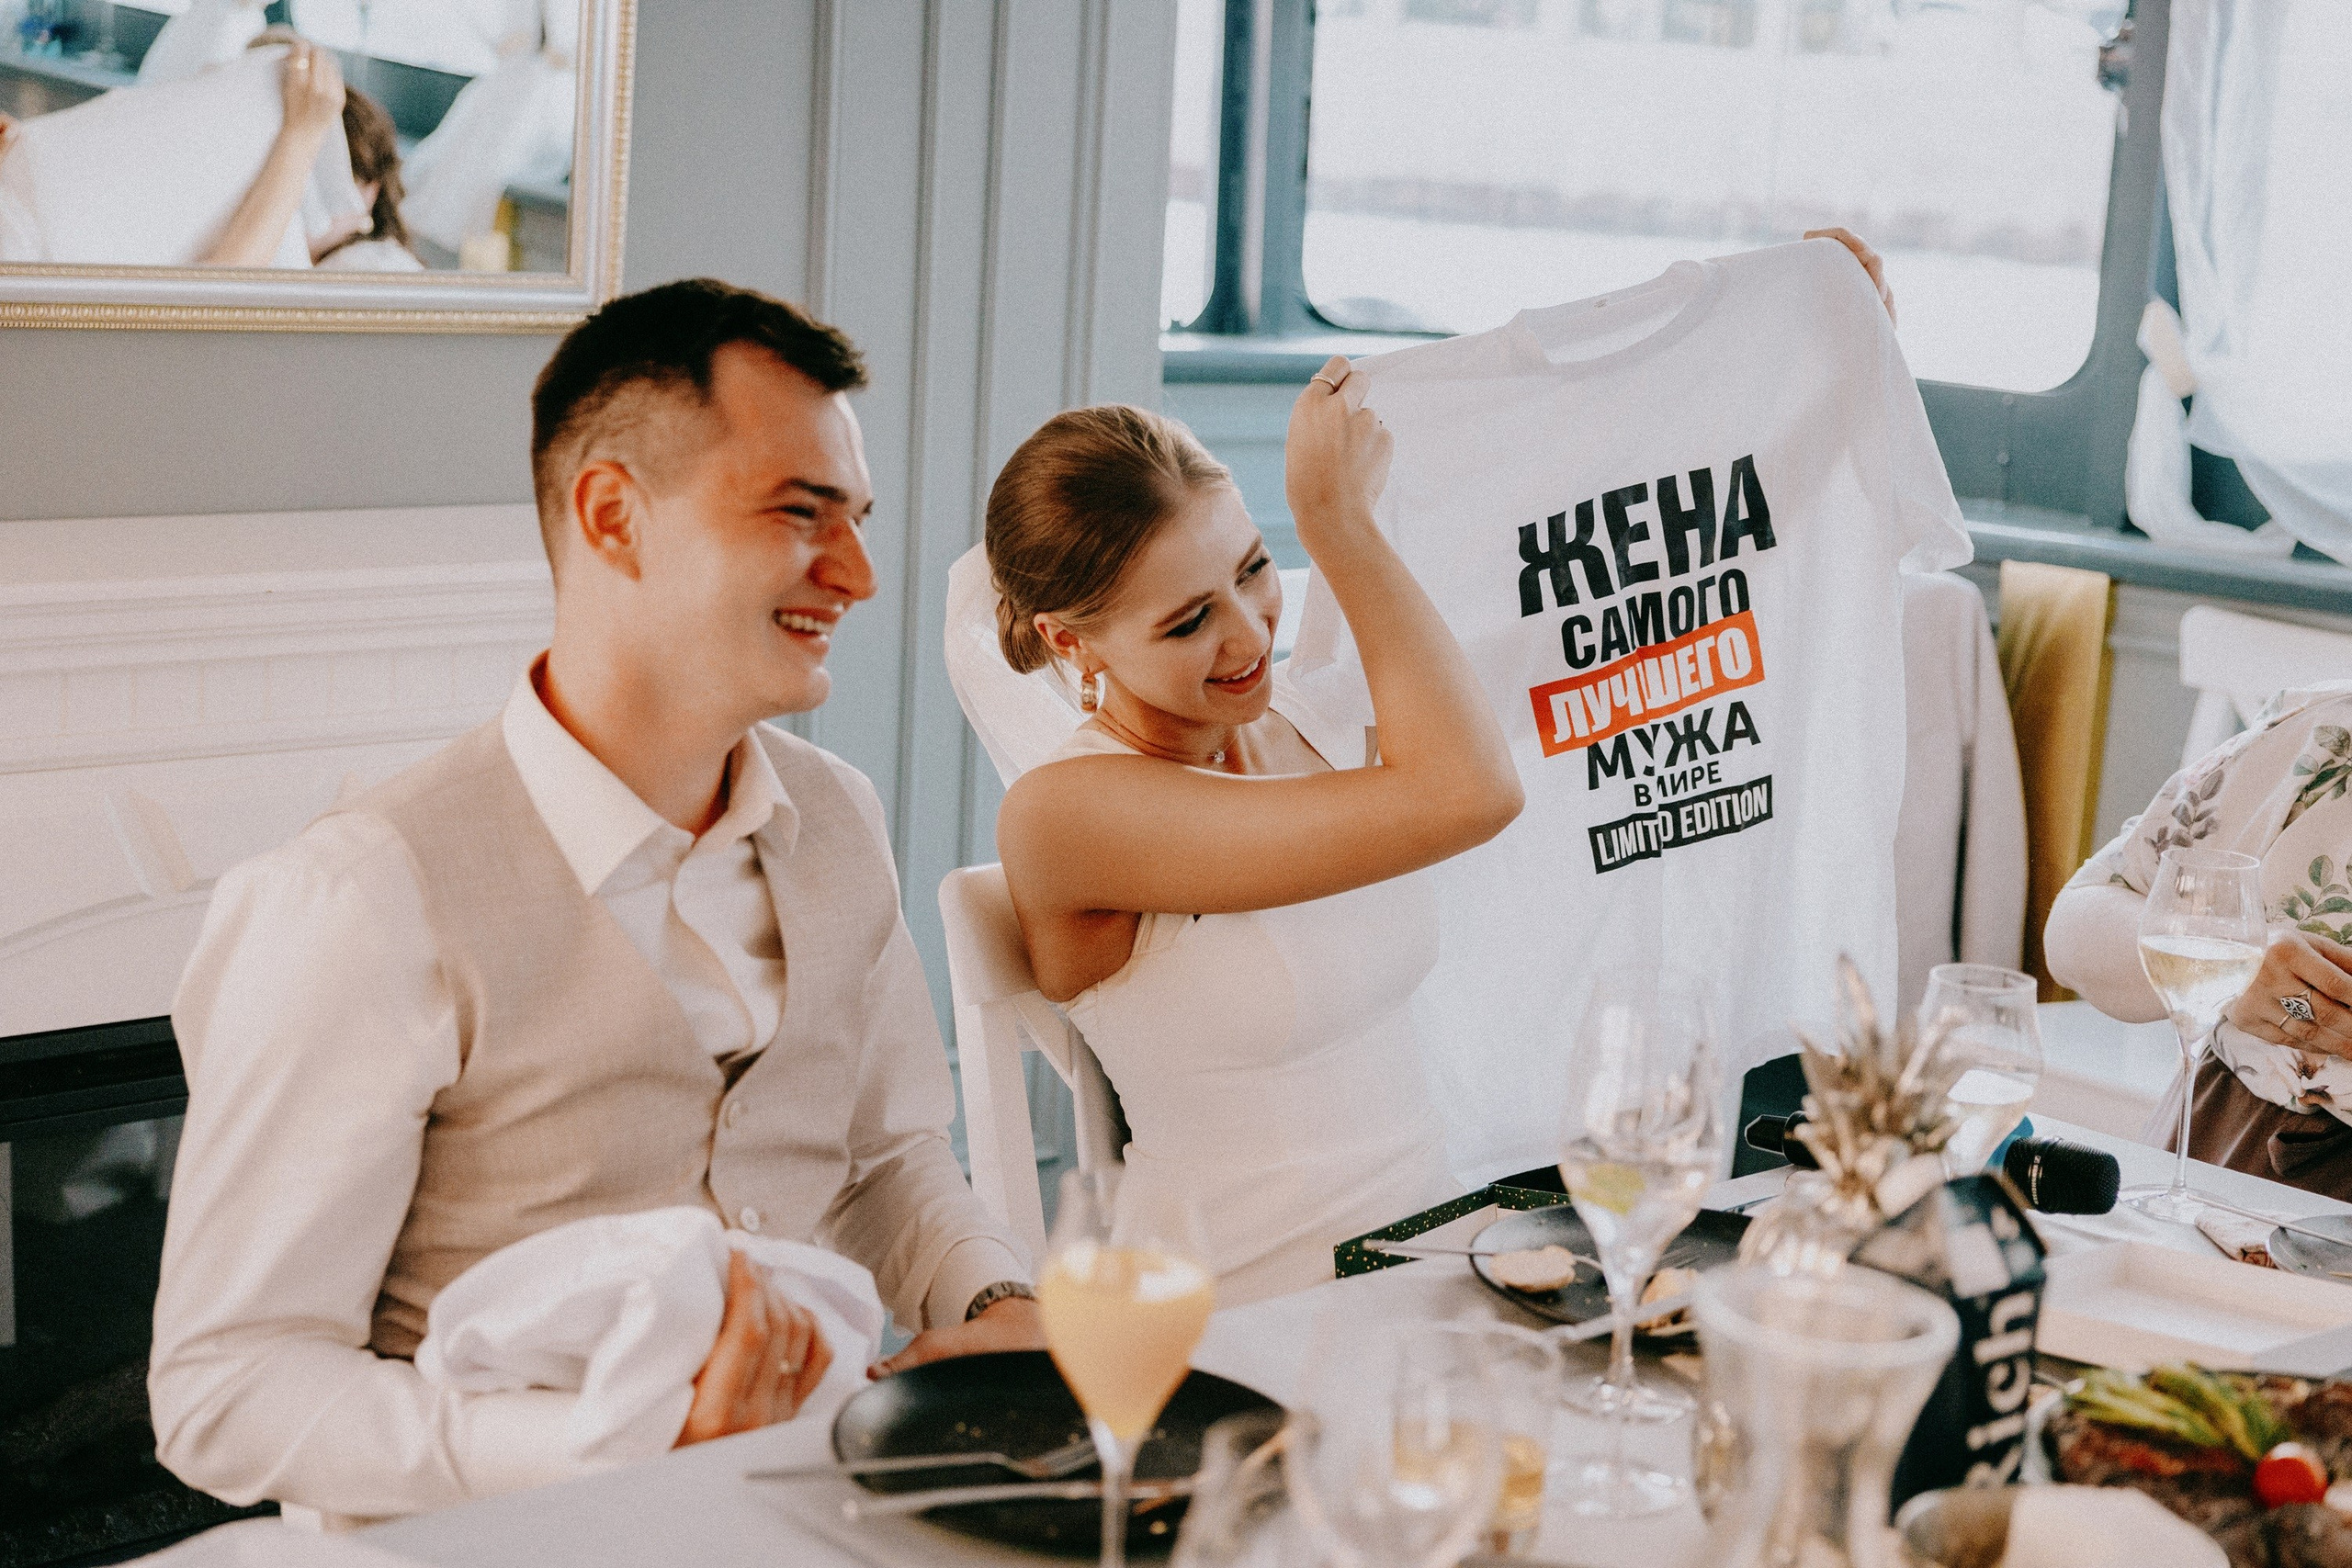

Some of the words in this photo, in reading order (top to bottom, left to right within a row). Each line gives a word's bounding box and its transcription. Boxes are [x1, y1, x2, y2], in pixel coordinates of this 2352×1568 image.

[1518, 454, 1777, 618] ЖЕНА
[1561, 568, 1750, 670] САМОГО
[1548, 627, 1752, 744] ЛУЧШЕГО
[1587, 700, 1761, 791] МУЖА
[1634, 783, 1653, 807] В
[1679, 783, 1768, 840] EDITION
